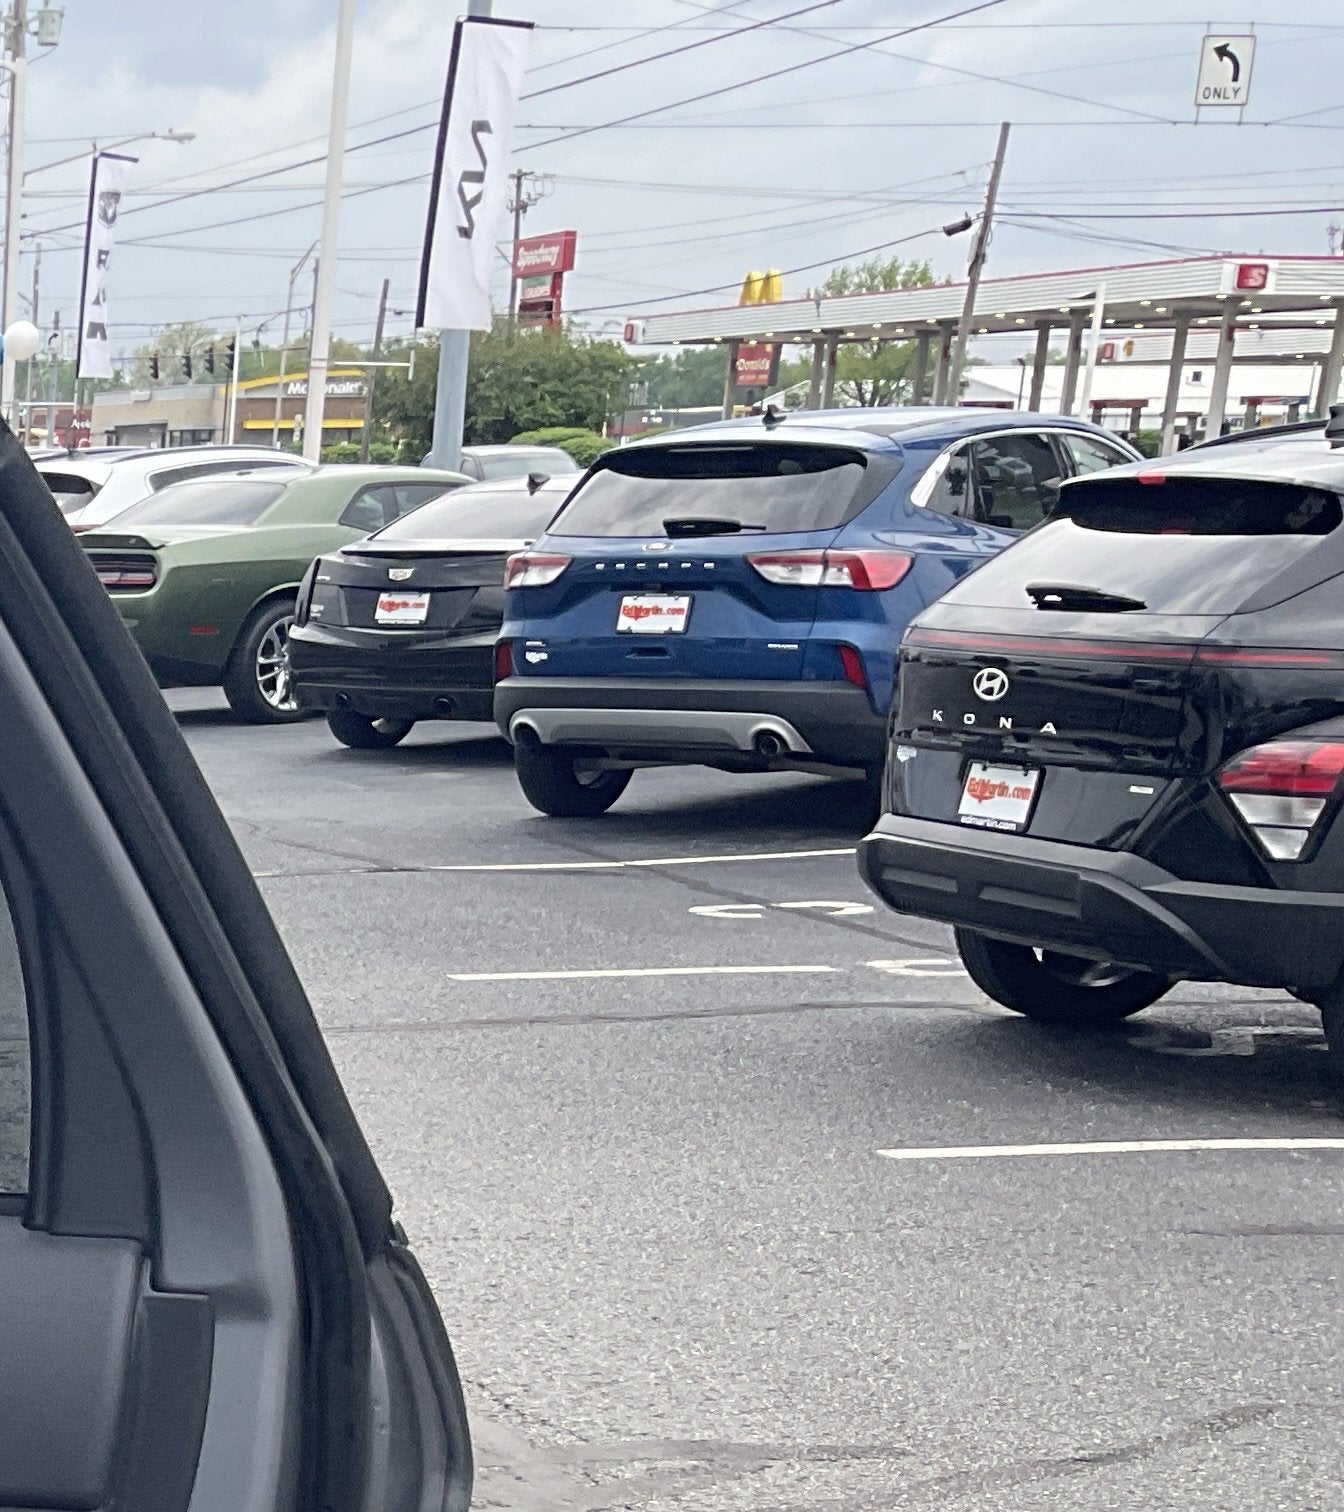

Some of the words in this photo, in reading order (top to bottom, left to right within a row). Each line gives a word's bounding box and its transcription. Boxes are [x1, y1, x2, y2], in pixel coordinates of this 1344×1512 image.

[1202, 86, 1241, 100] ONLY
[517, 243, 560, 271] Speedway
[932, 709, 1057, 735] KONA
